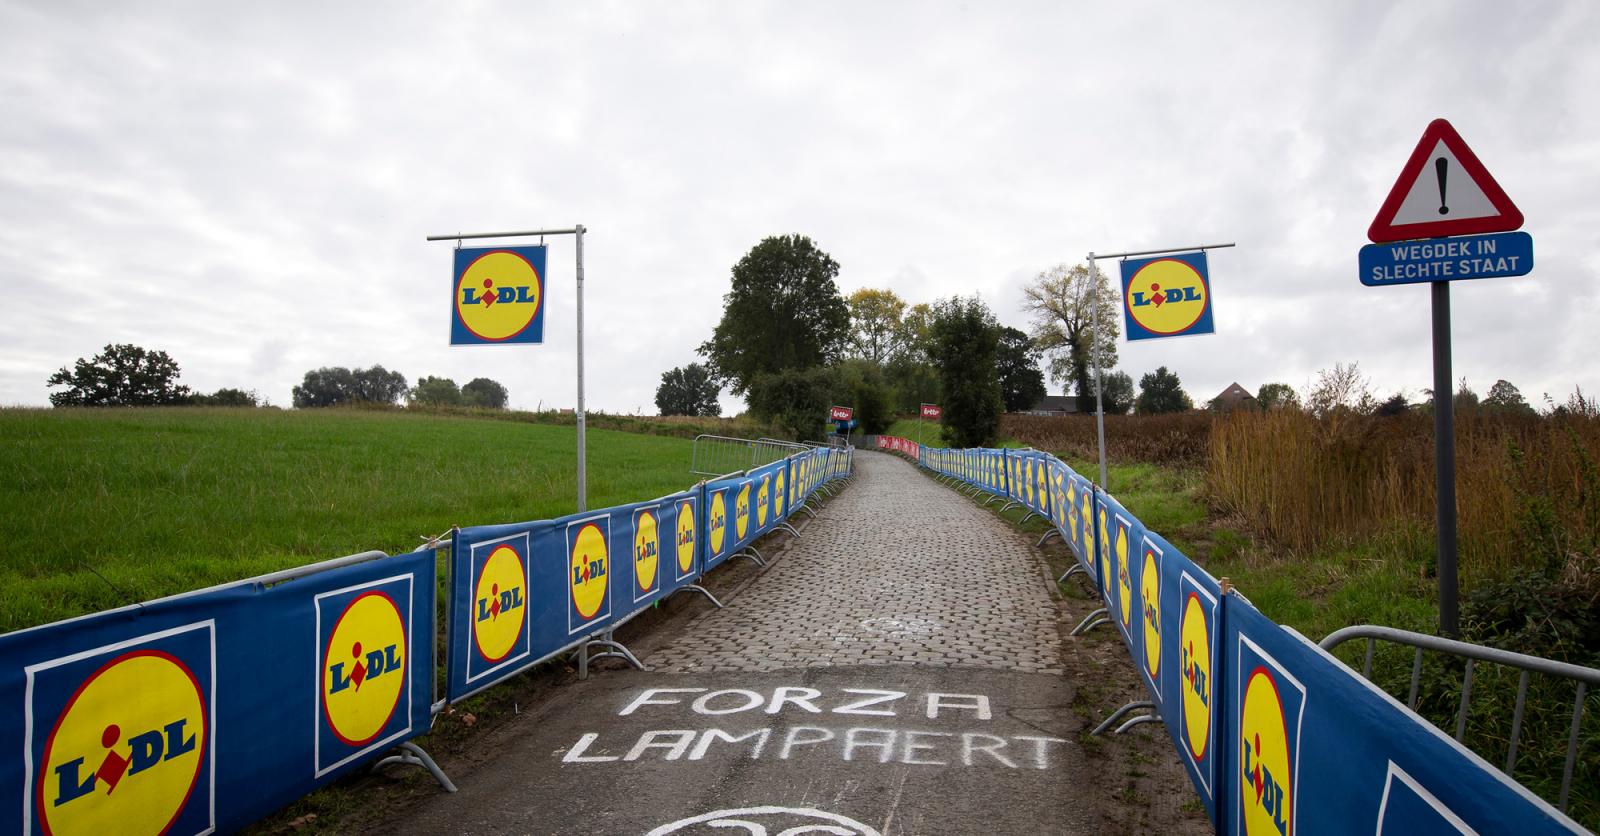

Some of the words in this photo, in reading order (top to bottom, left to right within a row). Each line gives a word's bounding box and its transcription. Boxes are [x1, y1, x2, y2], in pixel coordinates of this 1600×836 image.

[1391, 242, 1471, 261] WEGDEK
[1478, 239, 1496, 255] IN
[1372, 261, 1453, 281] SLECHTE
[1459, 256, 1519, 274] STAAT
[618, 687, 992, 720] FORZA
[561, 726, 1073, 770] LAMPAERT
